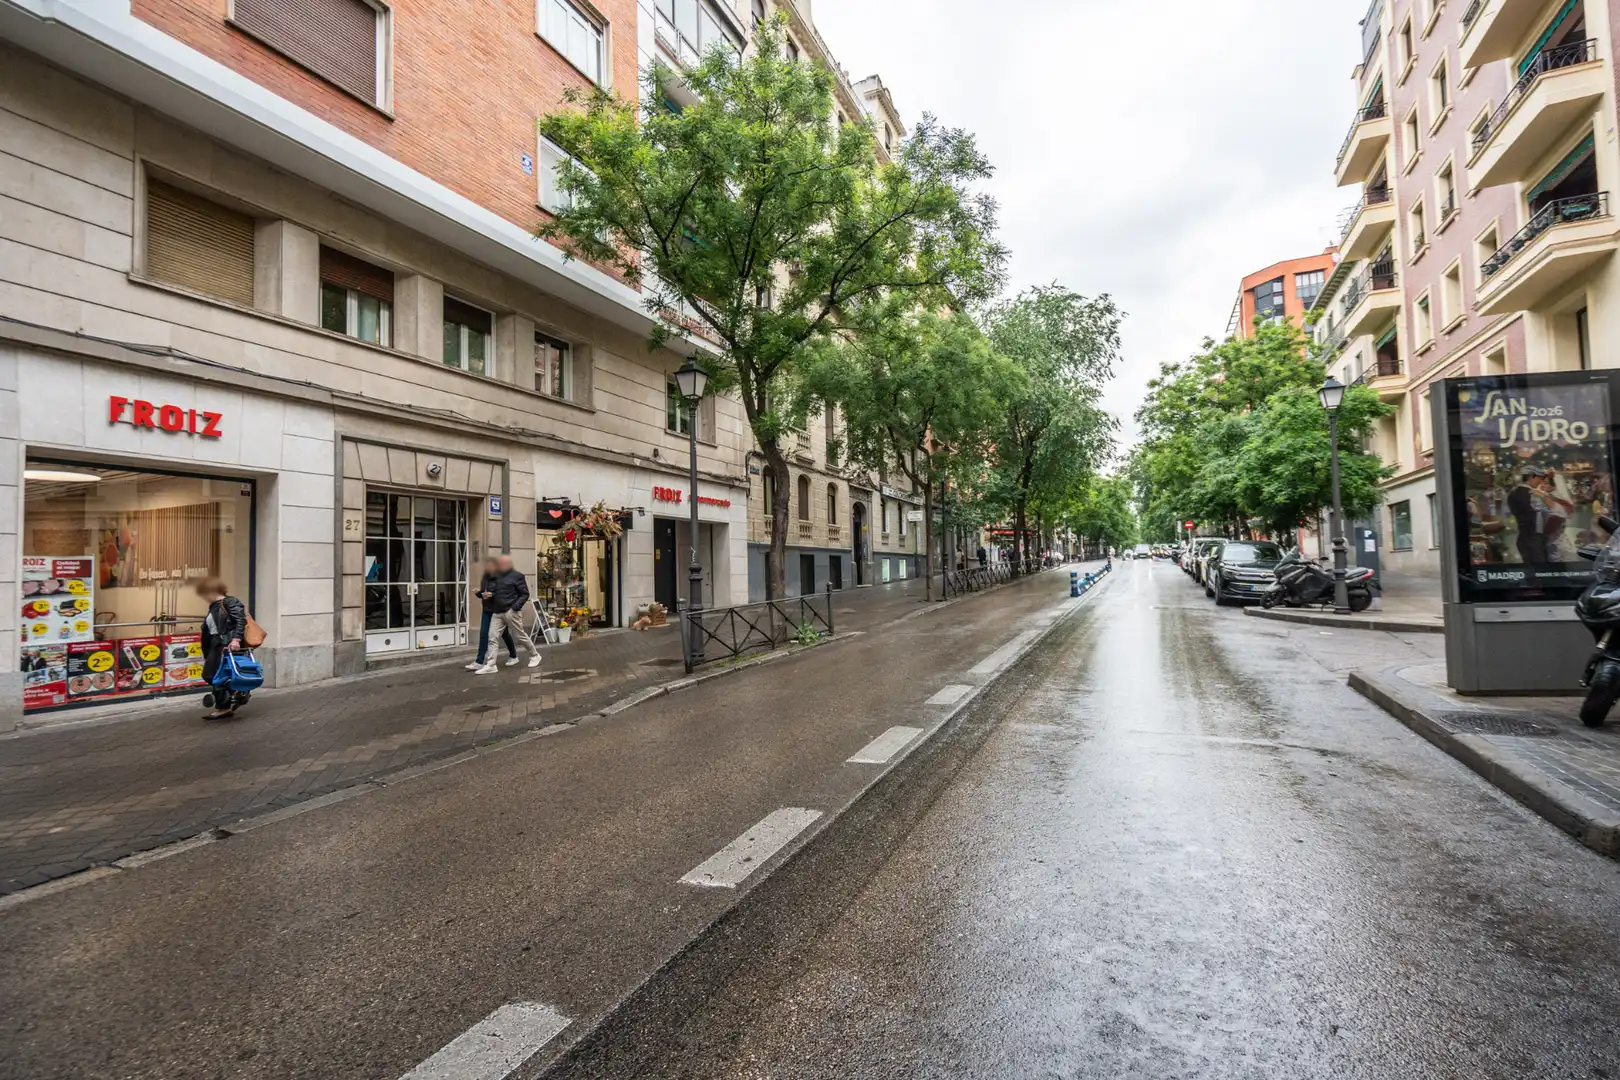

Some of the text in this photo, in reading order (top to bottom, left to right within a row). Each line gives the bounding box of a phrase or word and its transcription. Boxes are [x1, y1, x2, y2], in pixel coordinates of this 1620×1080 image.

[1474, 391, 1563, 423] SAN 2026
[109, 395, 223, 437] FROIZ
[1499, 416, 1589, 448] ISIDRO
[430, 464, 442, 475] 27
[653, 486, 682, 503] FROIZ
[345, 519, 360, 531] 27
[22, 558, 46, 566] ROIZ
[1488, 571, 1526, 581] MADRID
